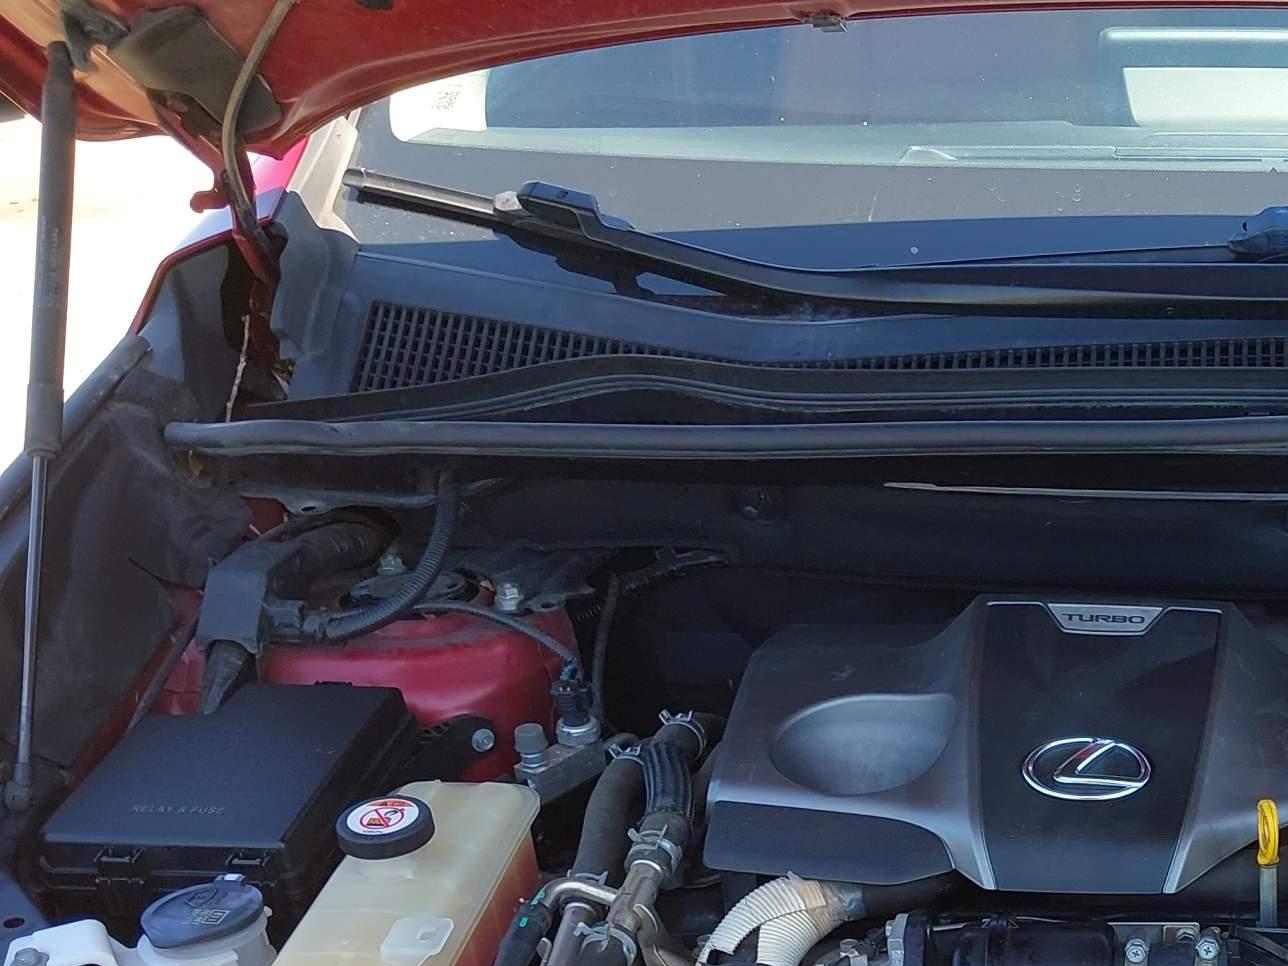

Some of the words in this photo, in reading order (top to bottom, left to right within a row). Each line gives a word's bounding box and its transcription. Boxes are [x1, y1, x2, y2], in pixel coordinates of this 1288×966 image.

[1062, 613, 1146, 624] TURBO
[133, 804, 173, 814] RELAY
[190, 806, 225, 815] FUSE
